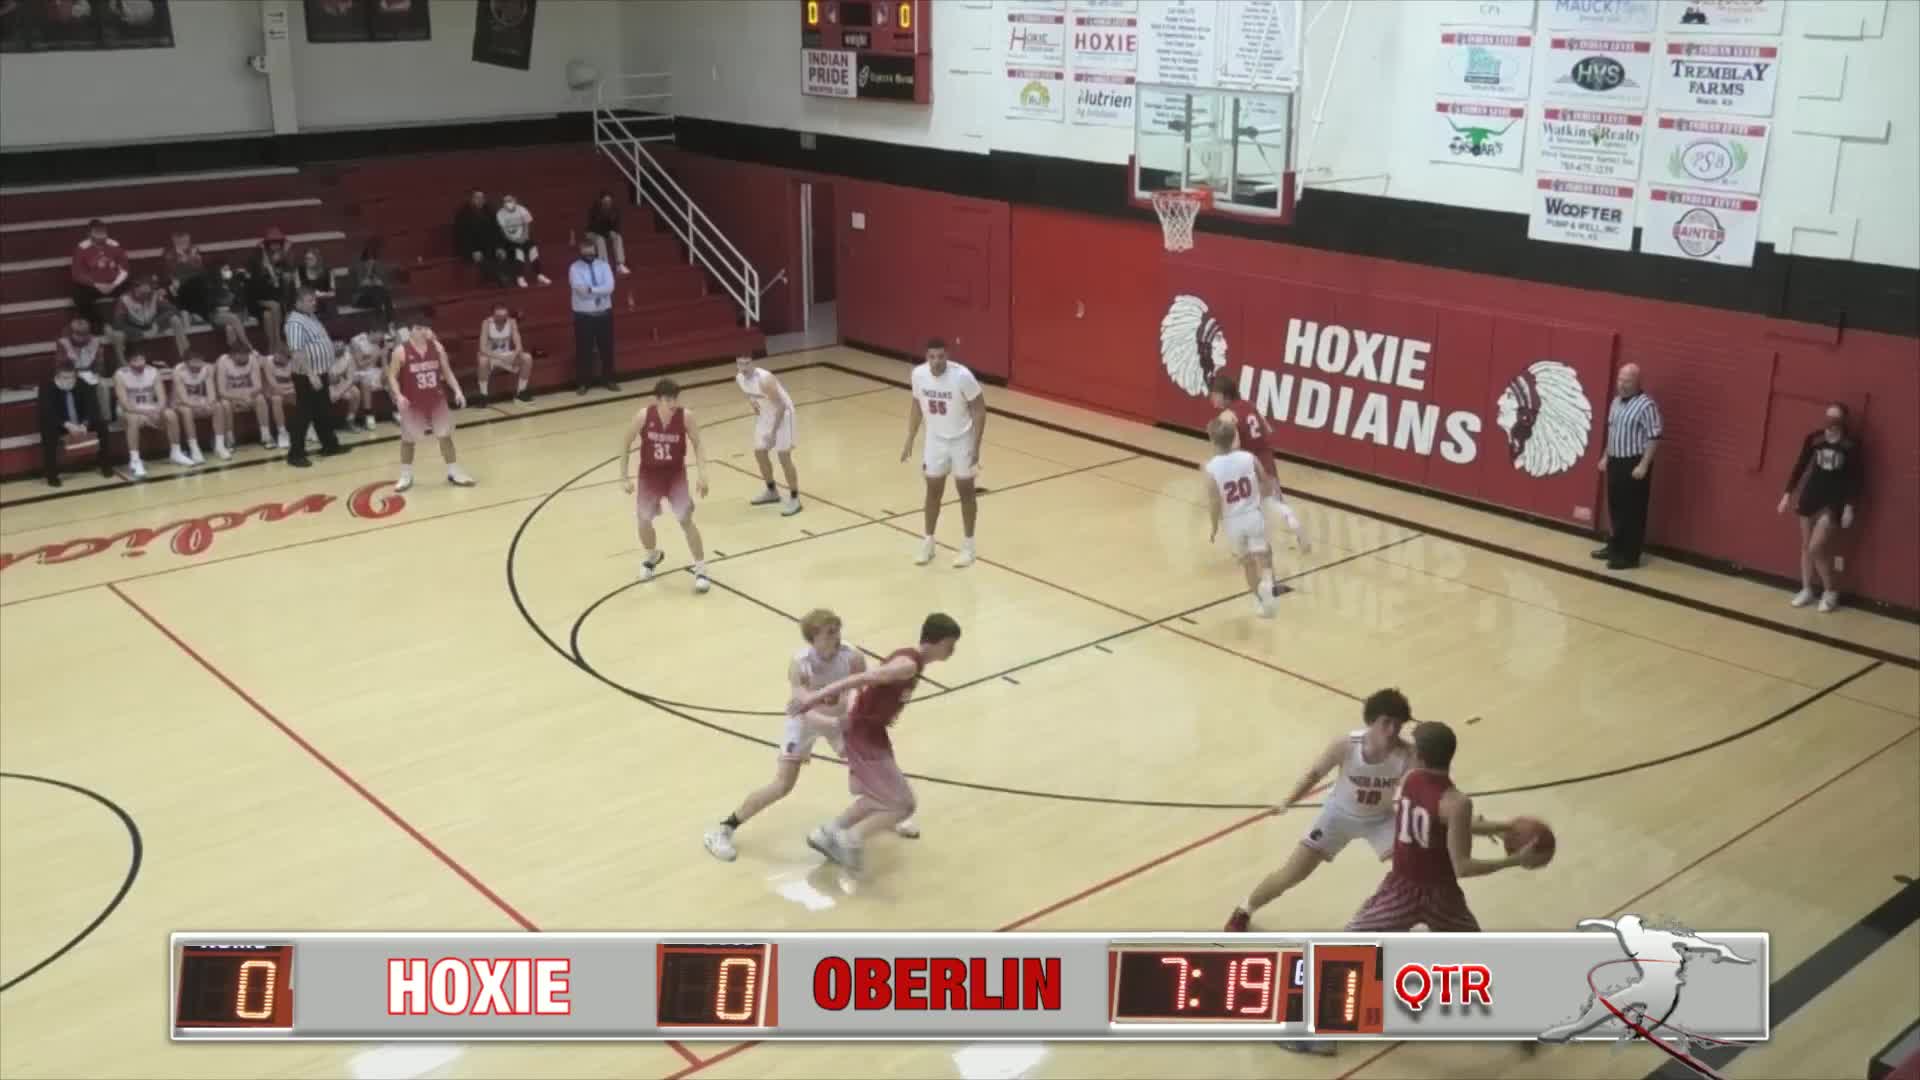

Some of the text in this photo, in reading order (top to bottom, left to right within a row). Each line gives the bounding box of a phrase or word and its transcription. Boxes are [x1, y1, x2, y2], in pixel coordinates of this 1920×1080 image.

[1074, 33, 1136, 52] HOXIE
[808, 52, 849, 67] INDIAN
[1671, 59, 1770, 81] TREMBLAY
[808, 66, 849, 86] PRIDE
[1577, 63, 1621, 85] HVS
[1078, 89, 1132, 108] Nutrien
[1689, 81, 1745, 97] FARMS
[1600, 126, 1640, 145] Realty
[1546, 197, 1622, 222] WOOFTER
[1284, 318, 1432, 391] HOXIE
[416, 370, 437, 389] 33
[1239, 364, 1482, 465] INDIANS
[1247, 414, 1262, 438] 2
[1224, 476, 1252, 504] 20
[0, 480, 407, 571] India
[1398, 799, 1431, 849] 10
